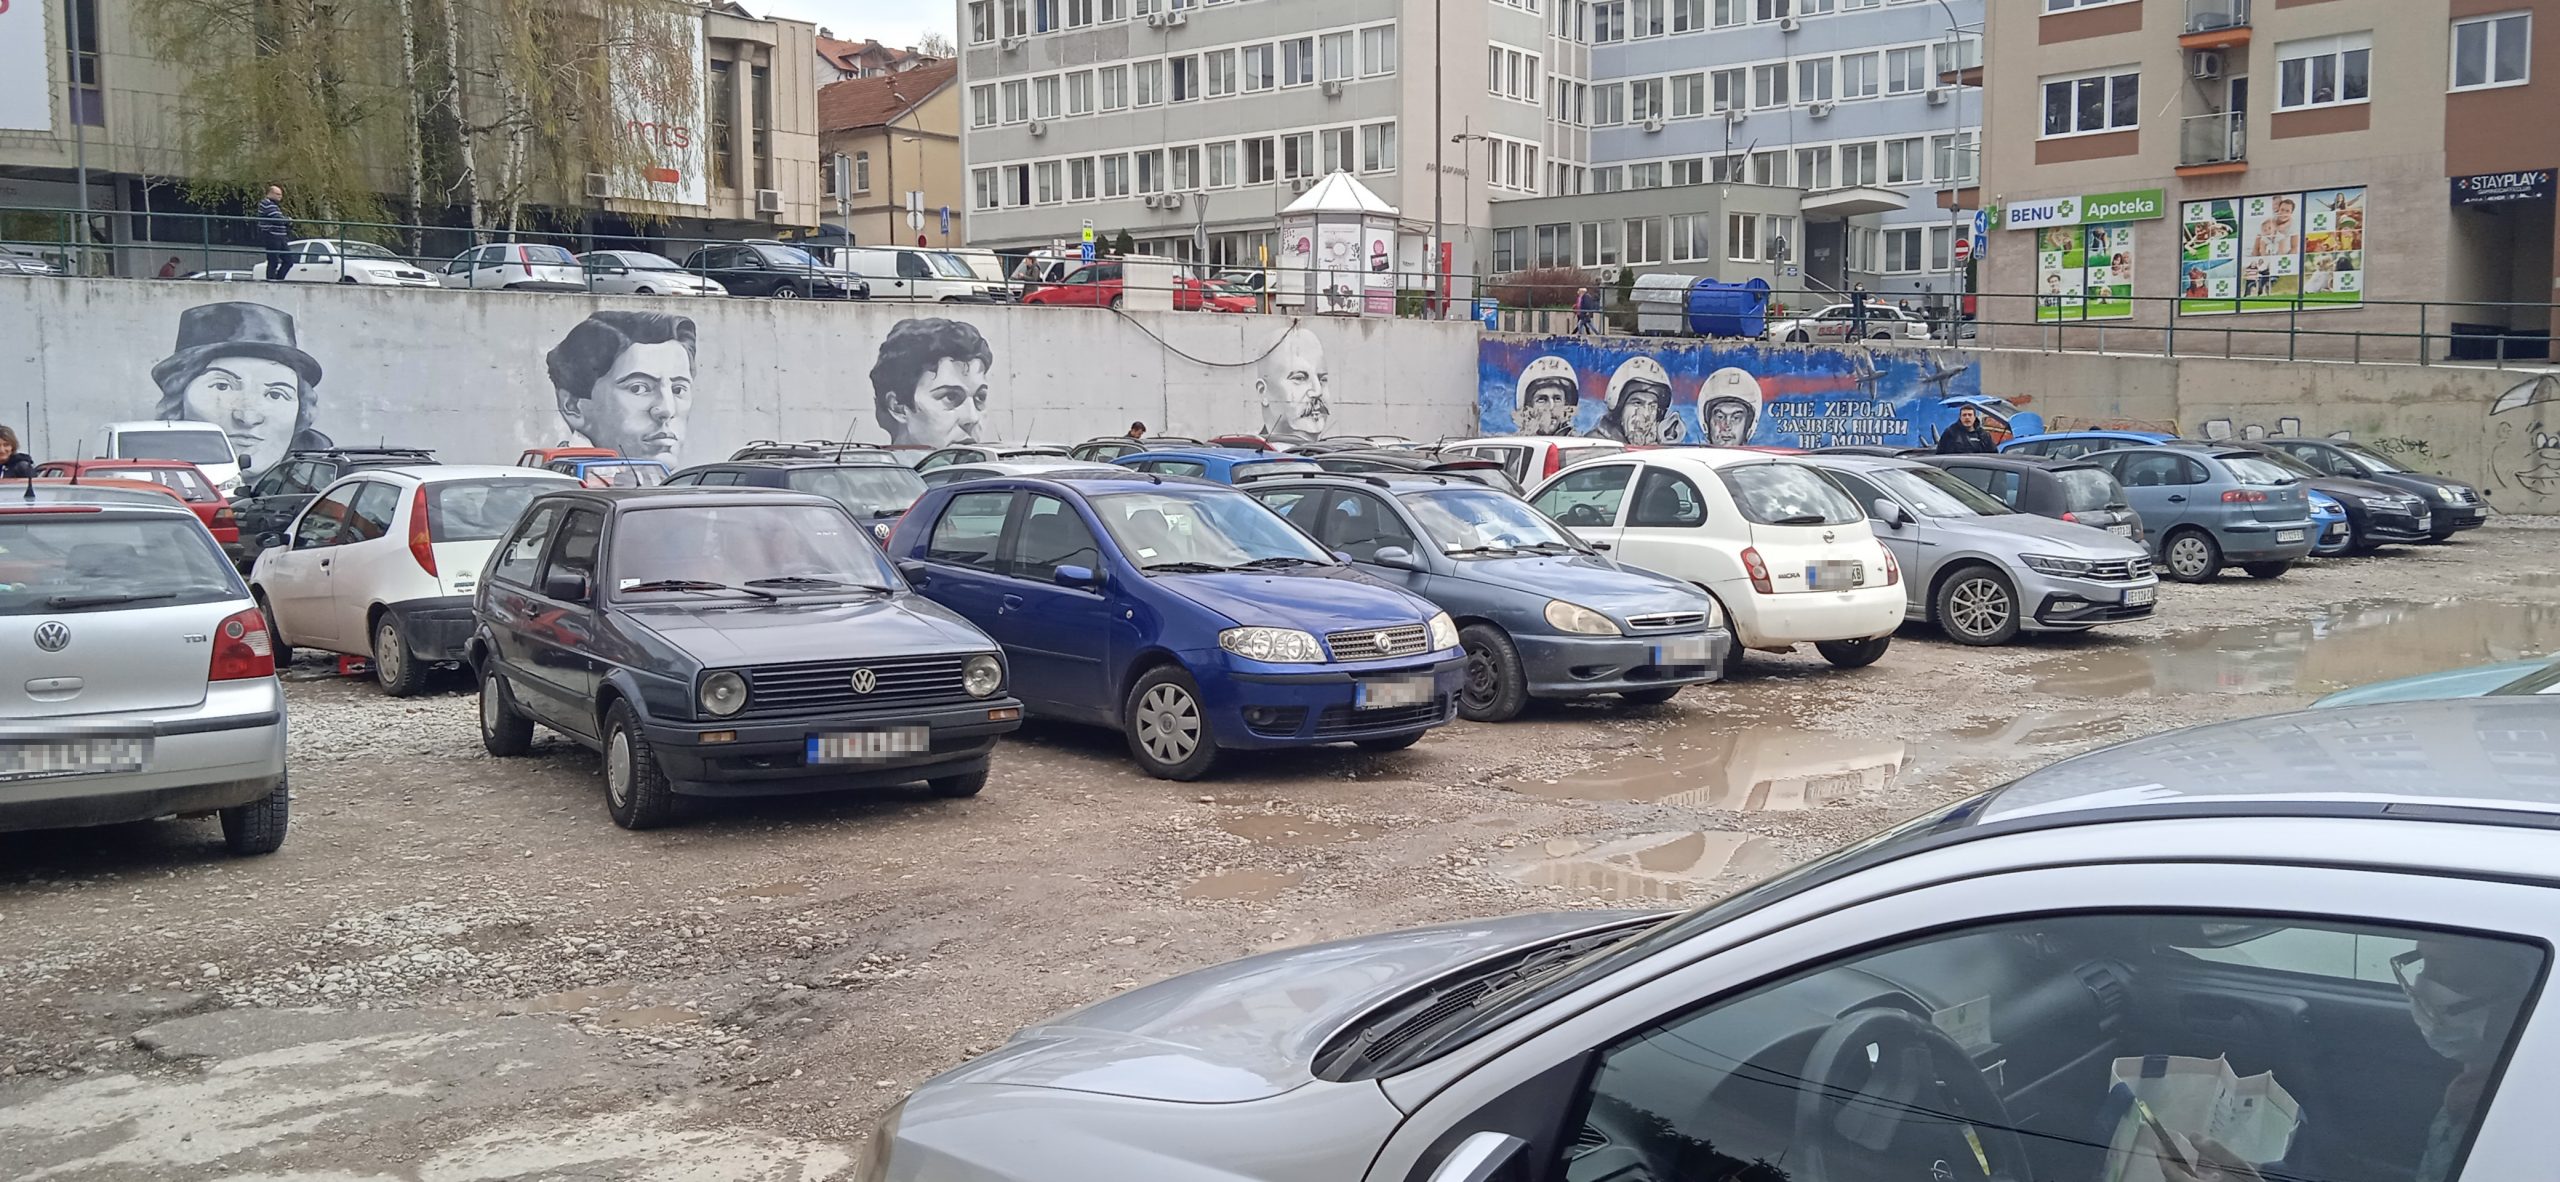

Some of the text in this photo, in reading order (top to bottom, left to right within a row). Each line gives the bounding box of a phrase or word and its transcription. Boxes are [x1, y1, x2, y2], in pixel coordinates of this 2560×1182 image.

[627, 119, 690, 148] mts
[2471, 172, 2538, 190] STAYPLAY
[2011, 198, 2154, 223] BENU Apoteka
[1767, 401, 1896, 418] СРЦЕ ХЕРОЈА
[1777, 419, 1847, 434] ЗАУВЕК
[1799, 434, 1822, 449] НЕ
[184, 633, 208, 644] TDI
